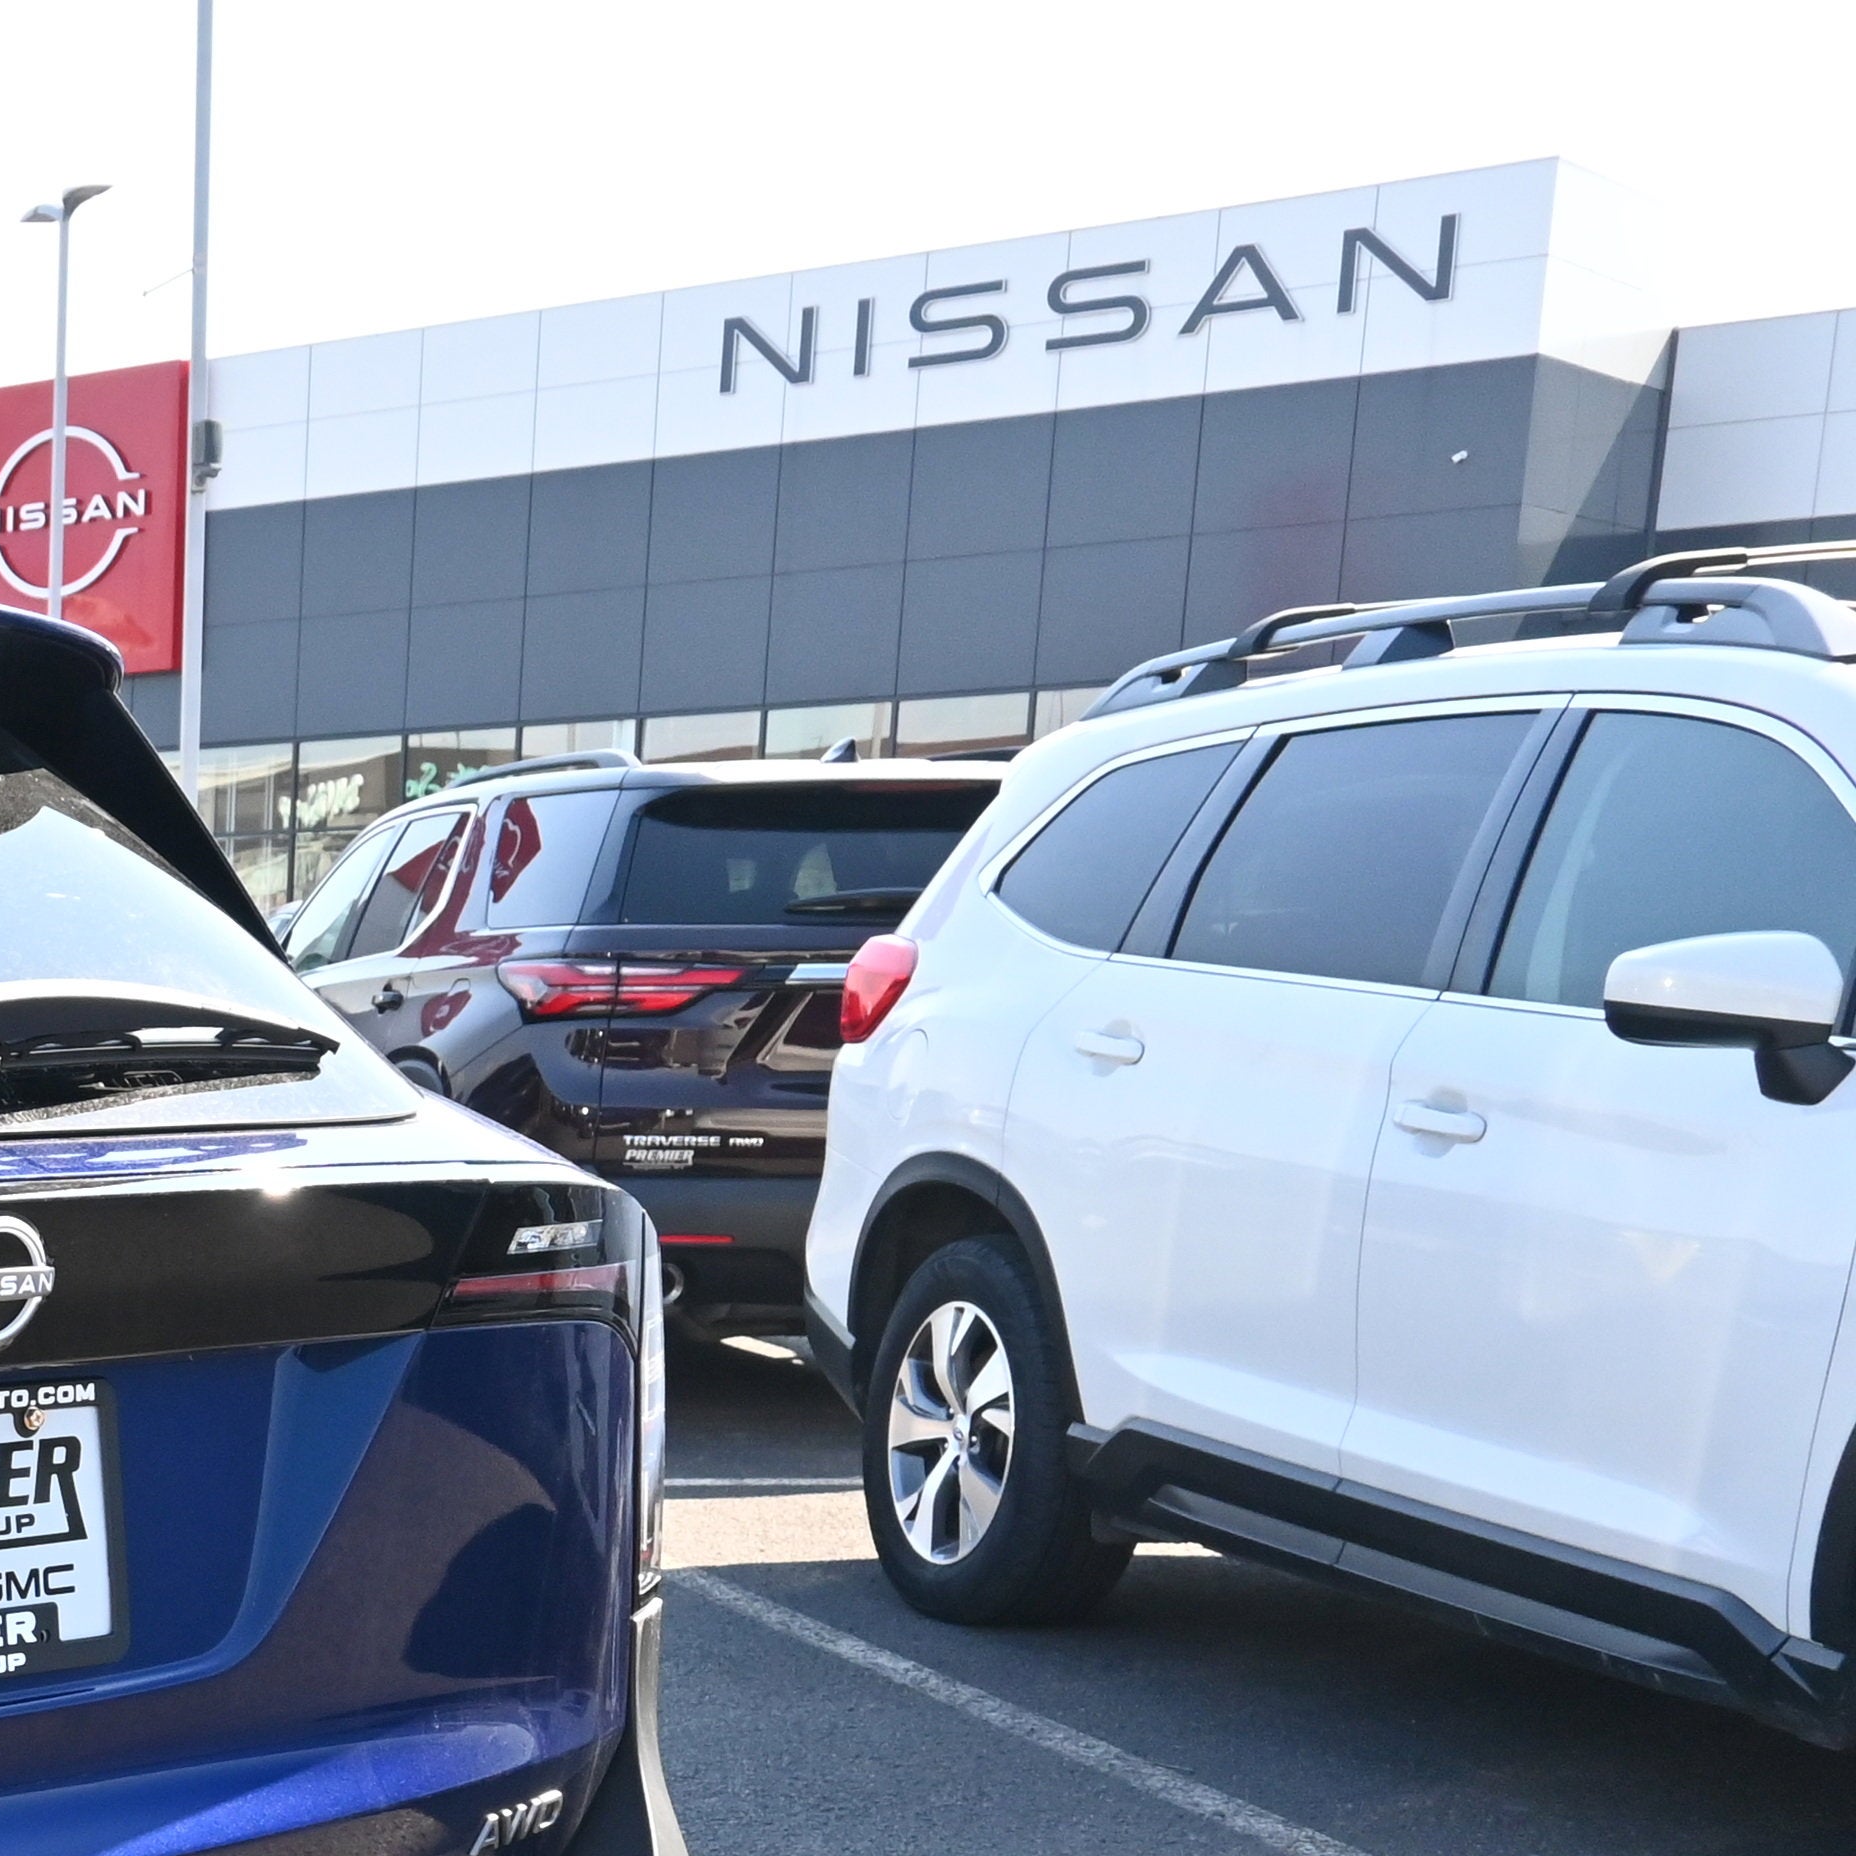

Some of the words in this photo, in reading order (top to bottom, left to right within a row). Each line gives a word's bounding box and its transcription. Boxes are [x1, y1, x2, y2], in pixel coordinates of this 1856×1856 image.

[719, 211, 1461, 396] NISSAN
[622, 1134, 722, 1148] TRAVERSE
[624, 1148, 695, 1166] PREMIER
[469, 1789, 564, 1856] AWD
